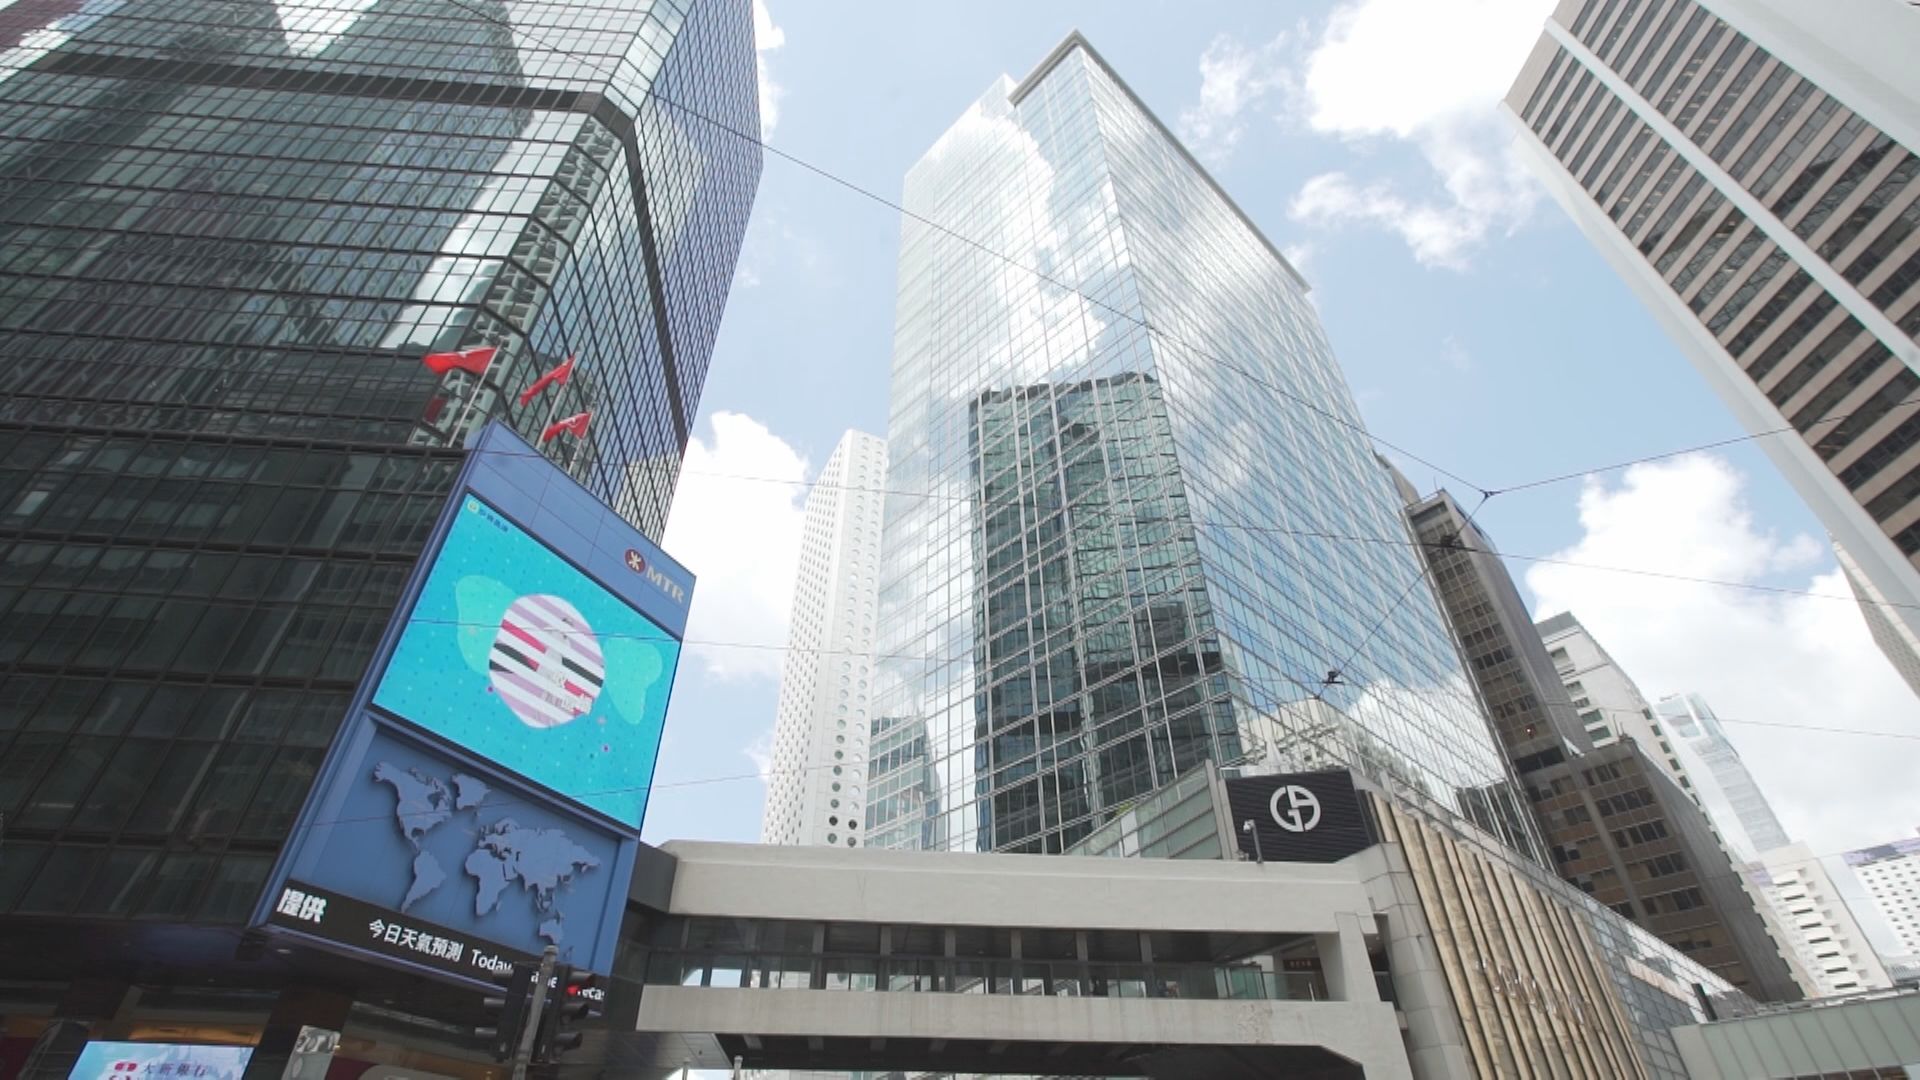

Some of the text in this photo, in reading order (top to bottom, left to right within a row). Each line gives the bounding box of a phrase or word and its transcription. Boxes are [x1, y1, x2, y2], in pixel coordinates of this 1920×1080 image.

[646, 566, 684, 603] MTR
[369, 919, 463, 962] 今日天氣預測
